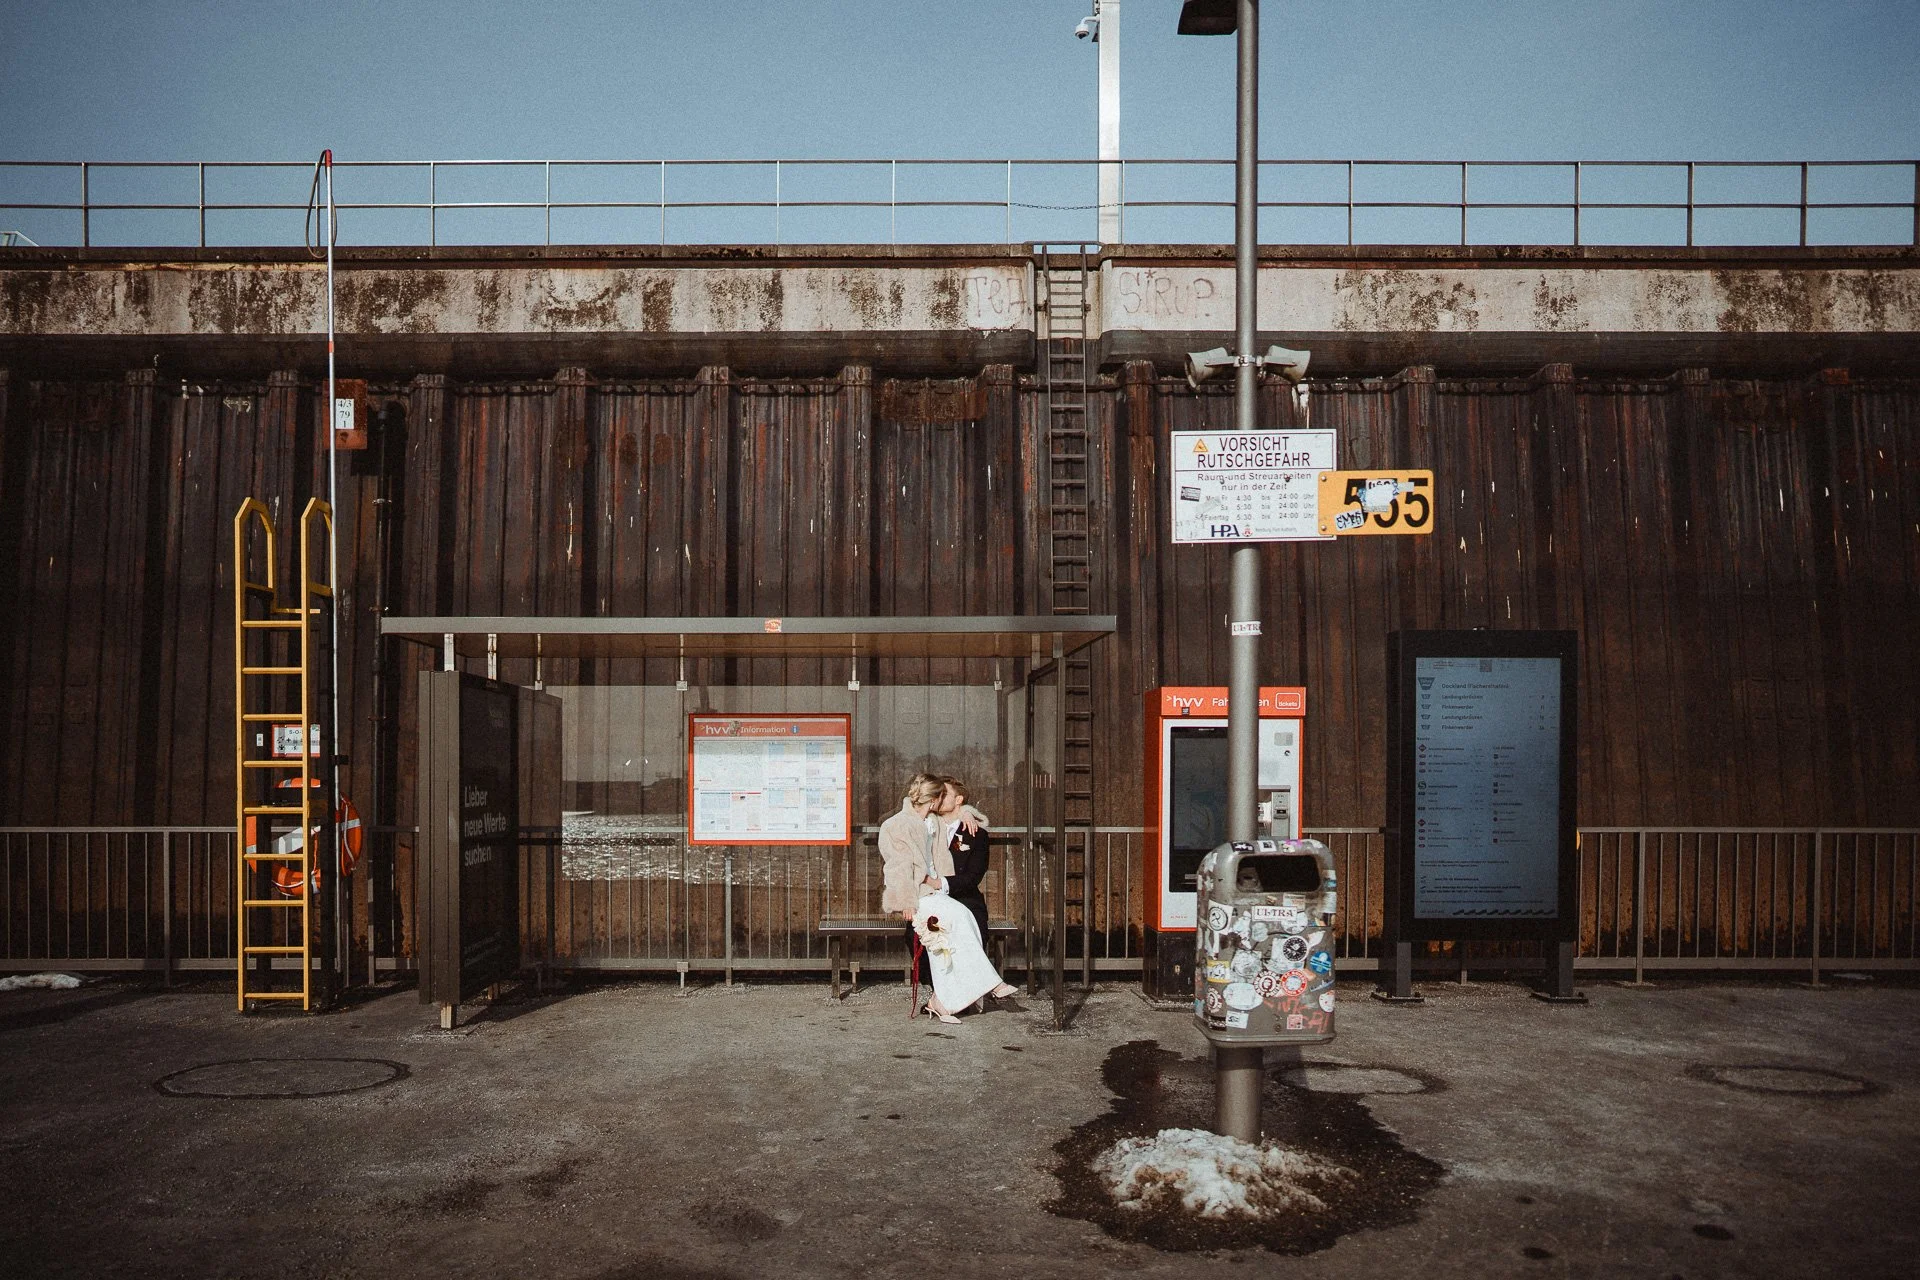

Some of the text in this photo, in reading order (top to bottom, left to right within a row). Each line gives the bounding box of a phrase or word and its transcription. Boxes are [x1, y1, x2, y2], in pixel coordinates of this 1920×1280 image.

[340, 410, 351, 418] 79
[1219, 436, 1290, 451] VORSICHT
[1197, 452, 1311, 468] RUTSCHGEFAHR
[1249, 472, 1312, 481] Streuarbeiten
[1240, 483, 1249, 491] in
[1251, 483, 1267, 491] der
[1269, 482, 1287, 490] Zeit
[1210, 524, 1240, 537] HPA
[1172, 695, 1204, 708] hvv
[705, 724, 786, 735] hvv Information
[464, 785, 489, 808] Lieber
[464, 811, 507, 837] neue Werte
[464, 843, 492, 867] suchen
[1256, 908, 1294, 918] ULTRA
